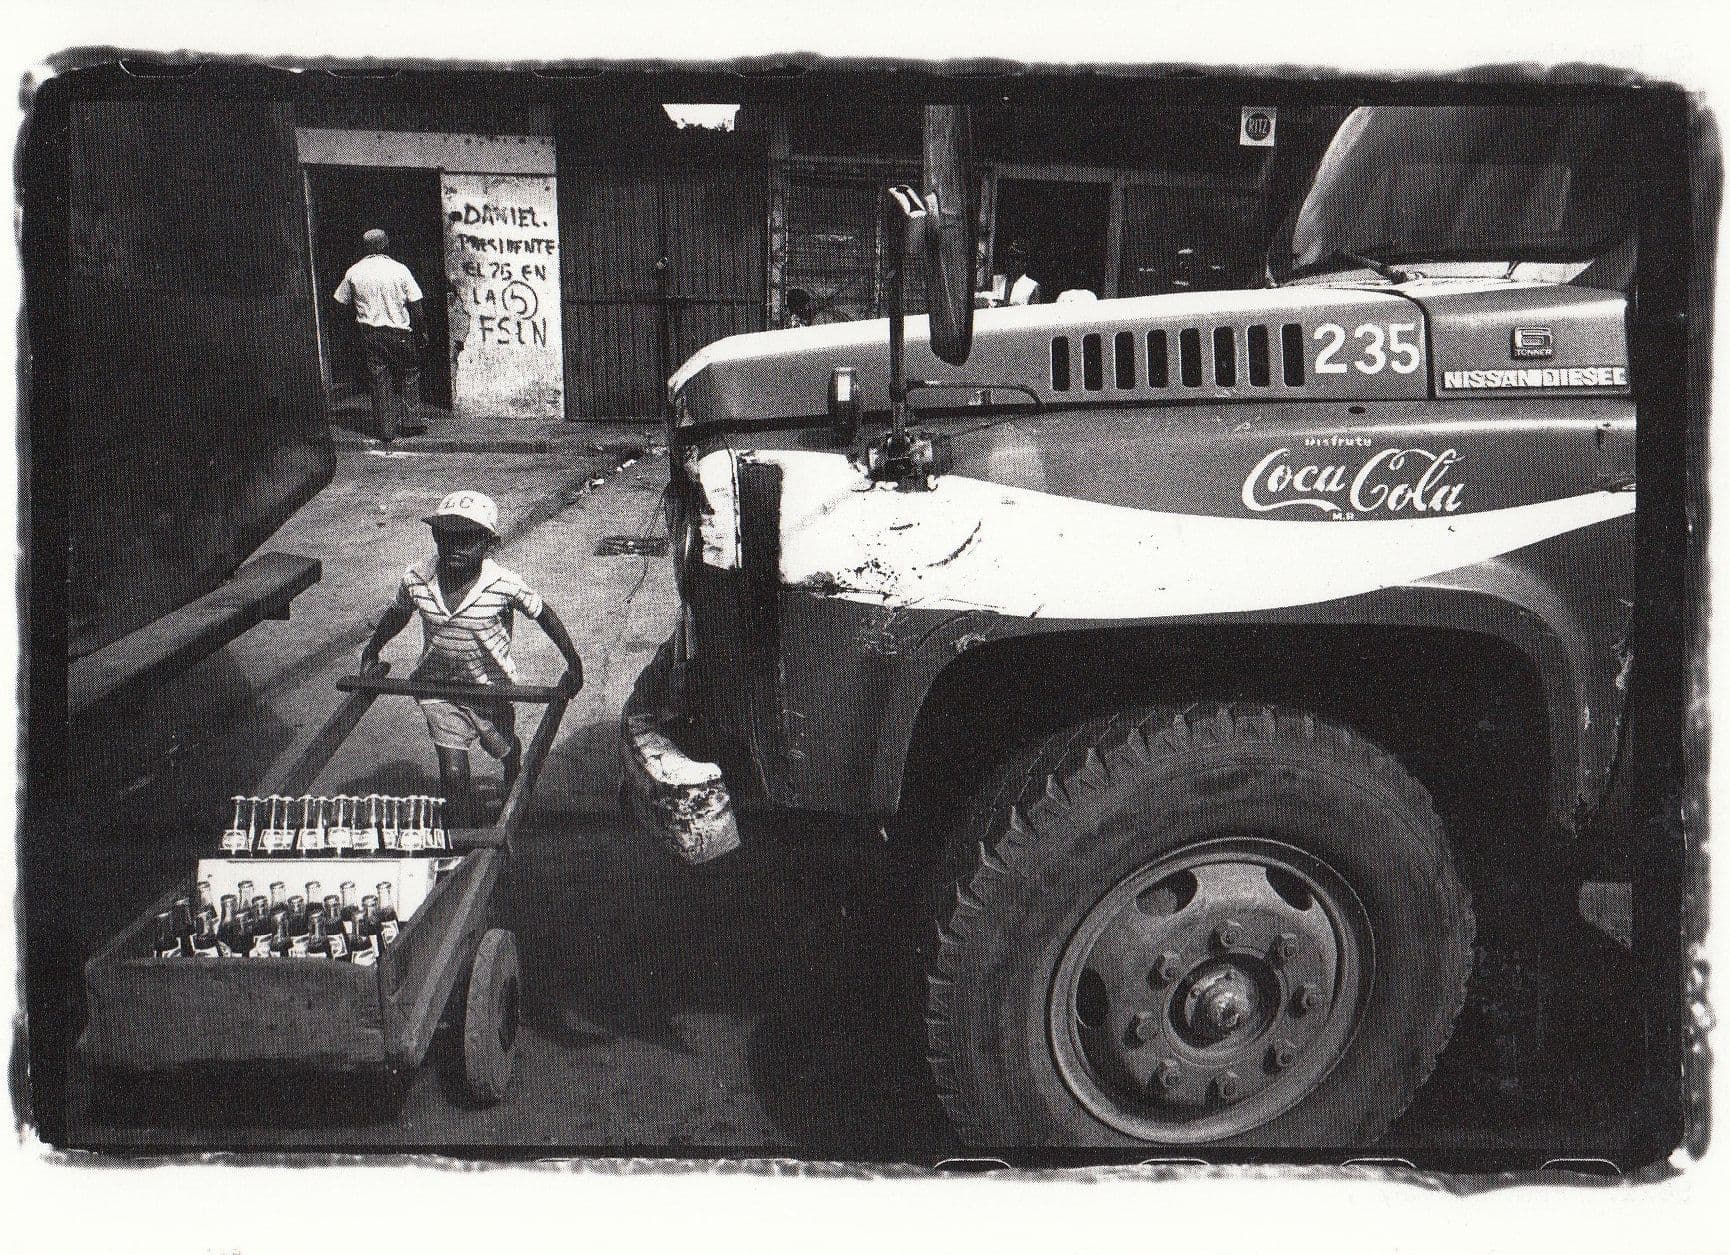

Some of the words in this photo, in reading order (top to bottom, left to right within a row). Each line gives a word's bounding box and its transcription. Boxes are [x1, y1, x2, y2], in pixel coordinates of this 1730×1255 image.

[1248, 118, 1269, 134] RITZ
[463, 262, 485, 278] EL
[521, 264, 546, 281] EN
[473, 287, 496, 306] LA
[478, 315, 547, 348] FSLN
[1312, 322, 1421, 376] 235
[1444, 370, 1533, 389] NISSAN
[1543, 367, 1627, 387] DIESEL
[1242, 448, 1346, 512] Coca
[1349, 448, 1466, 512] Cola
